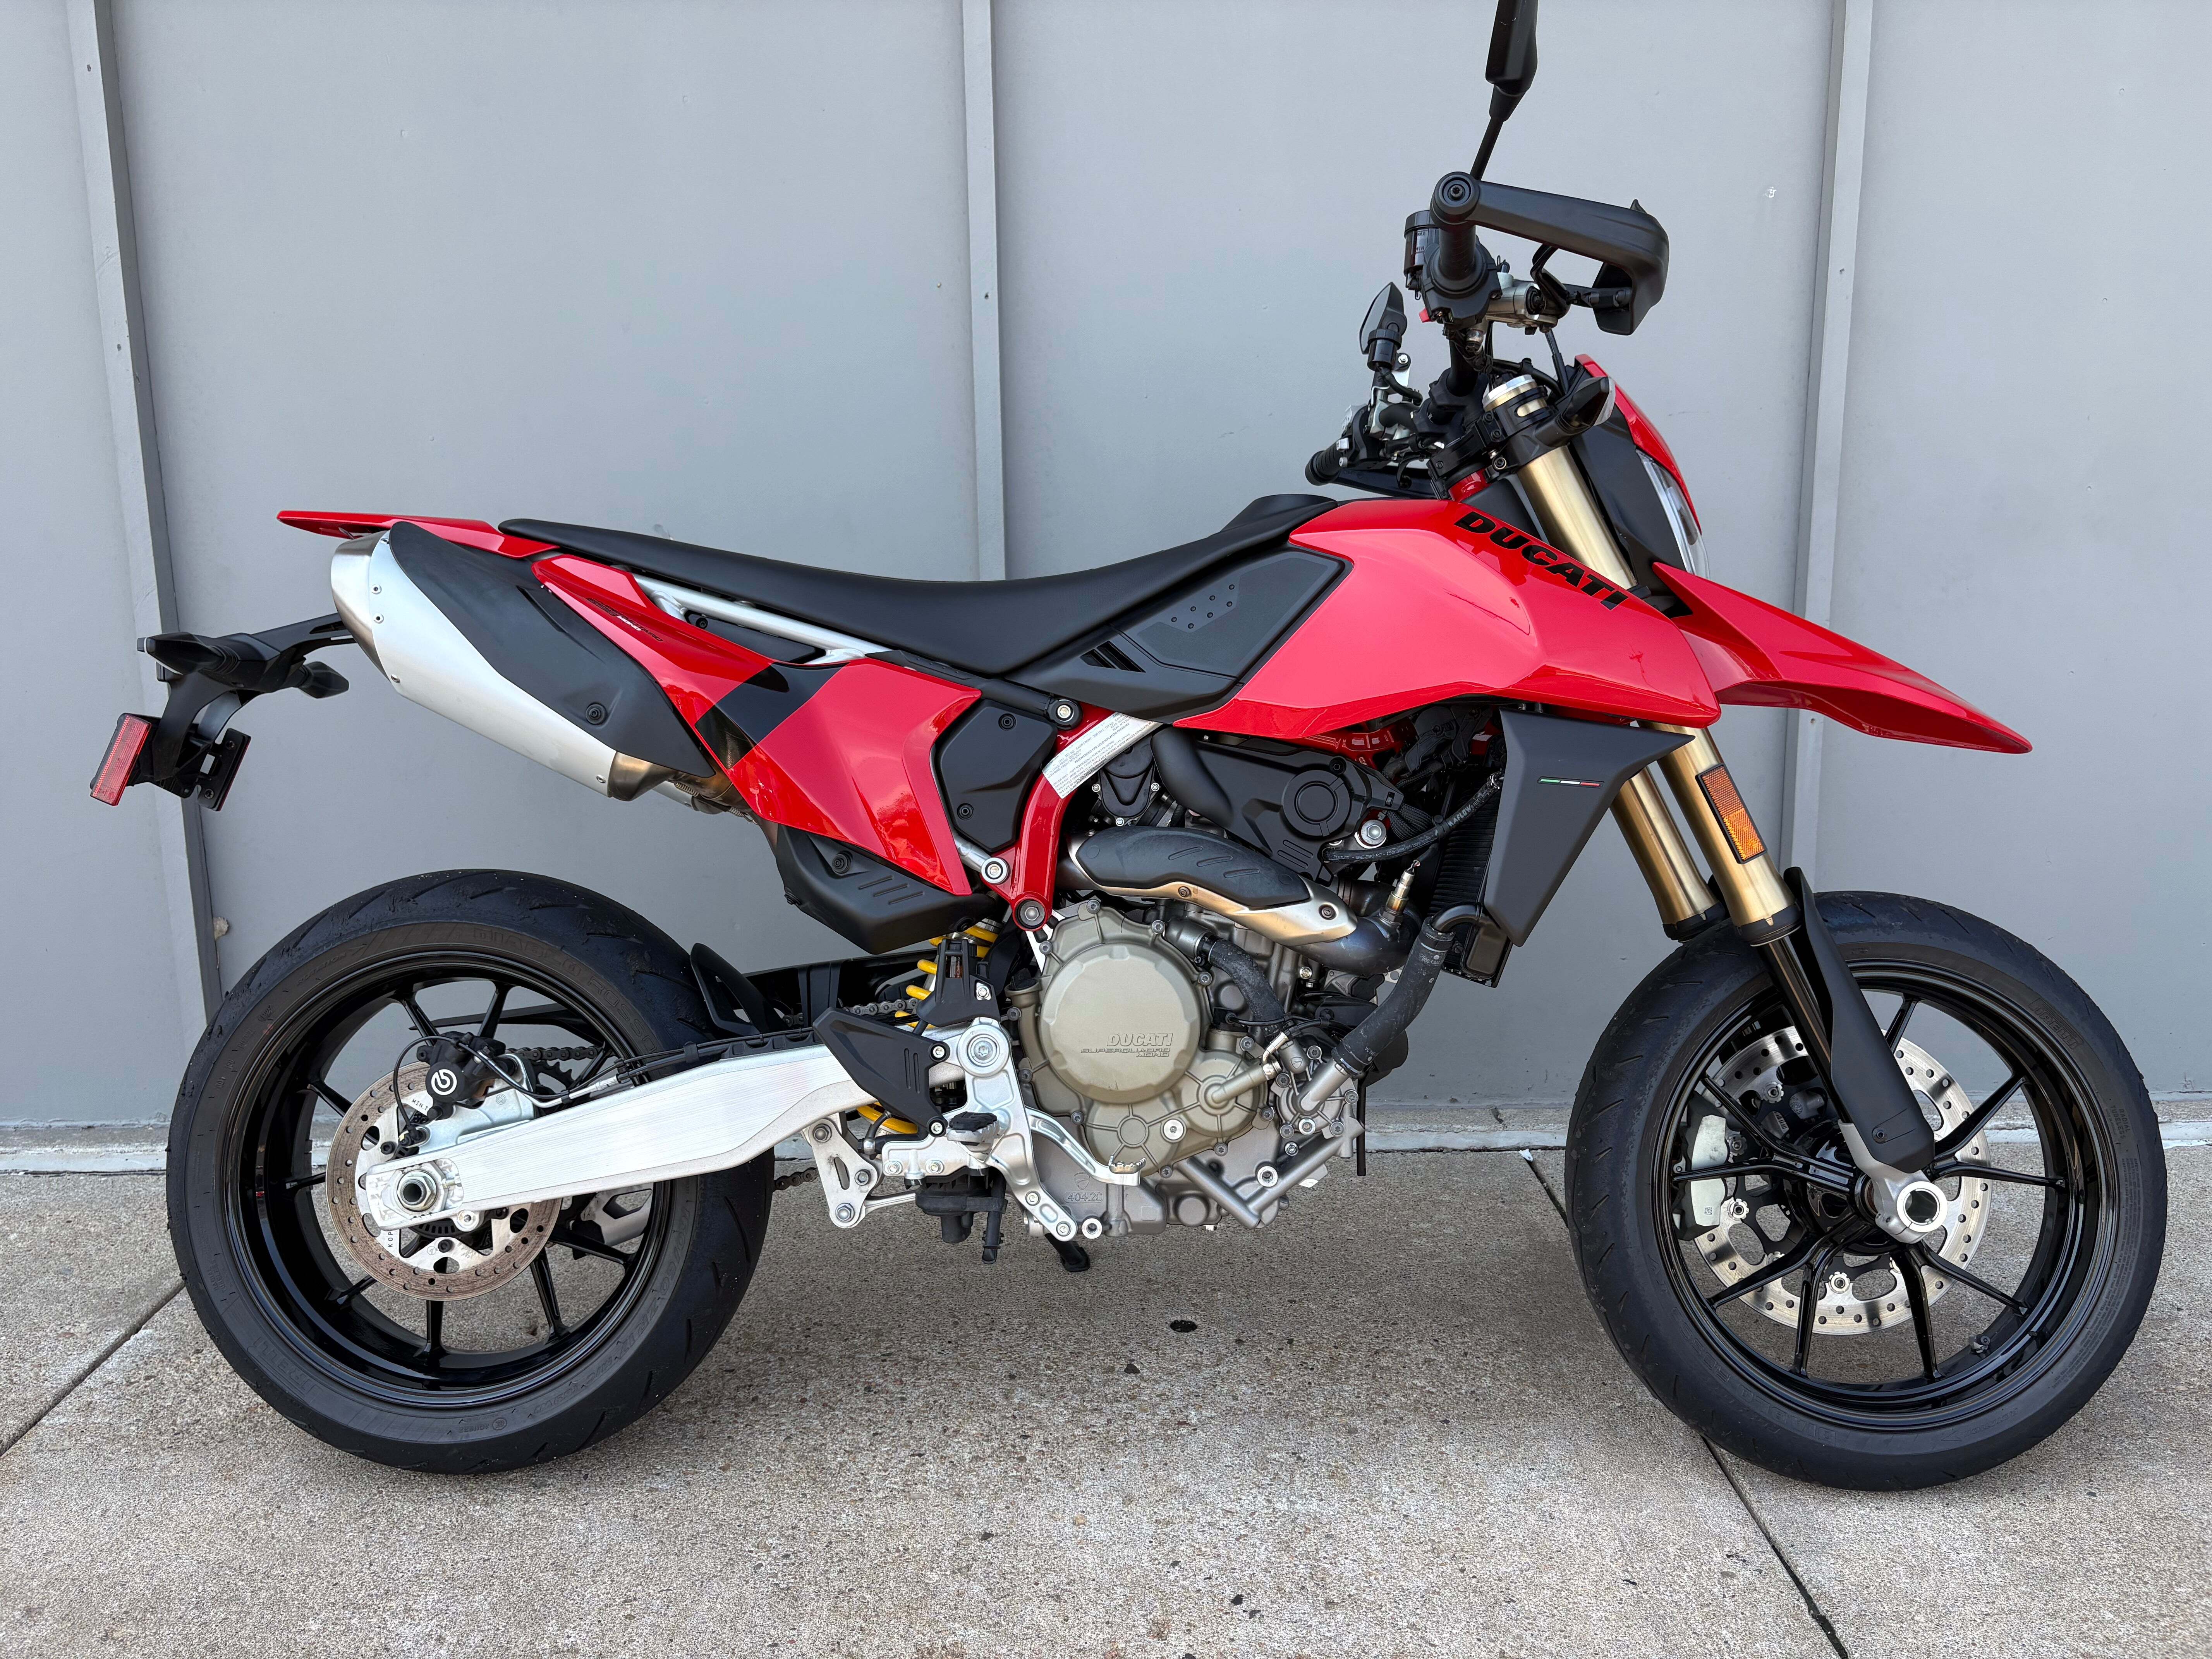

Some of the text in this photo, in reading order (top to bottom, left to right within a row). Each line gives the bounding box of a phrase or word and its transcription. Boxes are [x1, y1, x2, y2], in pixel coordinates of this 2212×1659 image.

[1454, 511, 1629, 610] DUCATI
[617, 615, 642, 631] MONO
[473, 927, 581, 977] DIABLO
[1106, 1033, 1173, 1046] DUCATI
[2028, 997, 2084, 1050] PIRELLI
[2111, 1105, 2126, 1139] TUBELESS
[2119, 1108, 2130, 1133] RADIAL
[1669, 1306, 1731, 1383] ROSSO
[247, 1336, 321, 1407] PIRELLI
[1736, 1383, 1837, 1443] DIABLO
